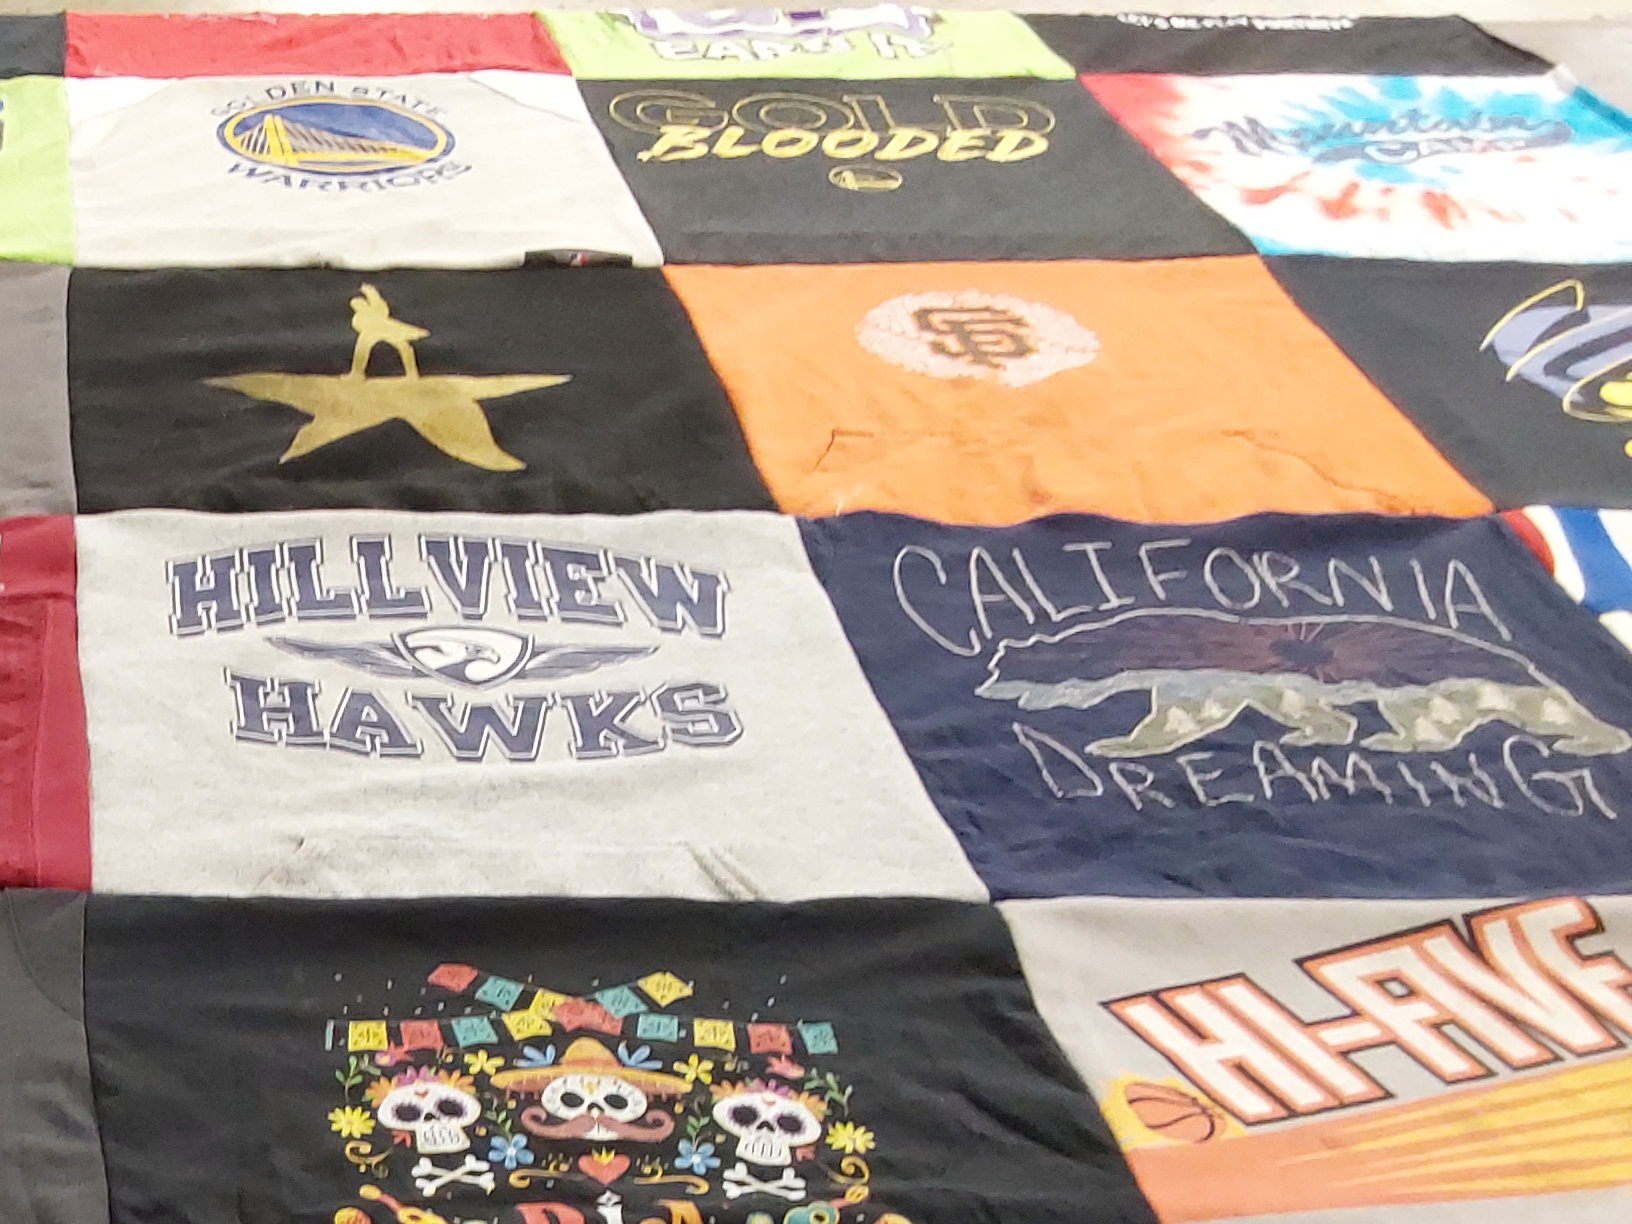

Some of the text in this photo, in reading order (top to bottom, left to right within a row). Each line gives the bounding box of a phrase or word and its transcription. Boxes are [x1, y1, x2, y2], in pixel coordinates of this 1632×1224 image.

[608, 89, 1056, 135] GOLD
[636, 125, 1051, 163] BLOODED
[226, 160, 474, 193] WARRIORS
[167, 532, 729, 637] HILLVIEW
[892, 538, 1512, 656] CALIFORNIA
[223, 666, 745, 762] HAWKS
[1011, 721, 1618, 820] DREAMING
